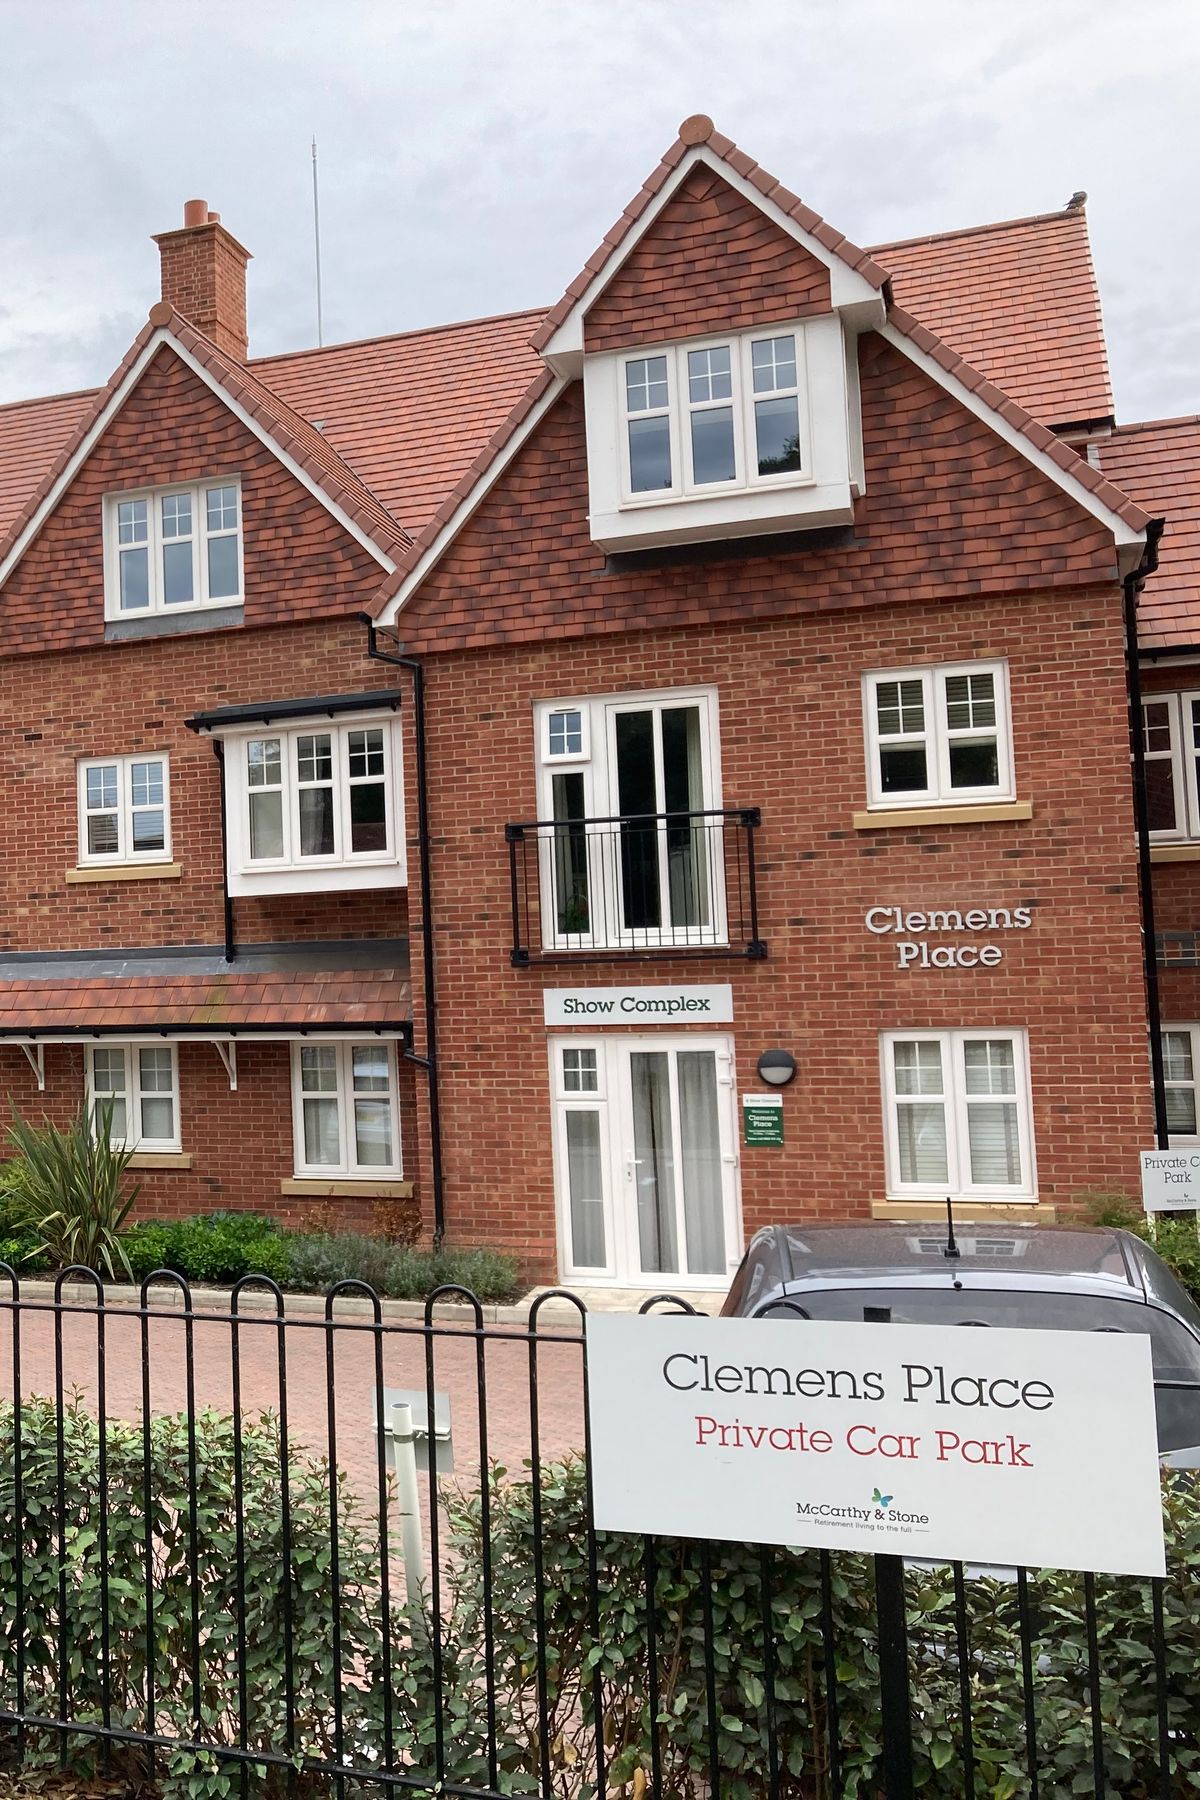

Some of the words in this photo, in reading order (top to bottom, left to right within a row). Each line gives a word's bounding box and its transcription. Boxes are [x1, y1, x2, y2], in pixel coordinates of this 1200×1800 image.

[865, 906, 1032, 934] Clemens
[896, 941, 1003, 968] Place
[563, 998, 615, 1014] Show
[620, 996, 711, 1015] Complex
[1144, 1156, 1187, 1169] Private
[1189, 1155, 1200, 1168] C
[1163, 1170, 1192, 1184] Park
[662, 1353, 885, 1401] Clemens
[902, 1364, 1055, 1411] Place
[695, 1415, 833, 1453] Private
[846, 1424, 919, 1460] Car
[935, 1430, 1034, 1468] Park
[796, 1502, 871, 1521] McCarthy
[874, 1508, 885, 1521] &
[888, 1510, 929, 1524] Stone
[814, 1518, 854, 1529] Retirement
[855, 1521, 875, 1531] living
